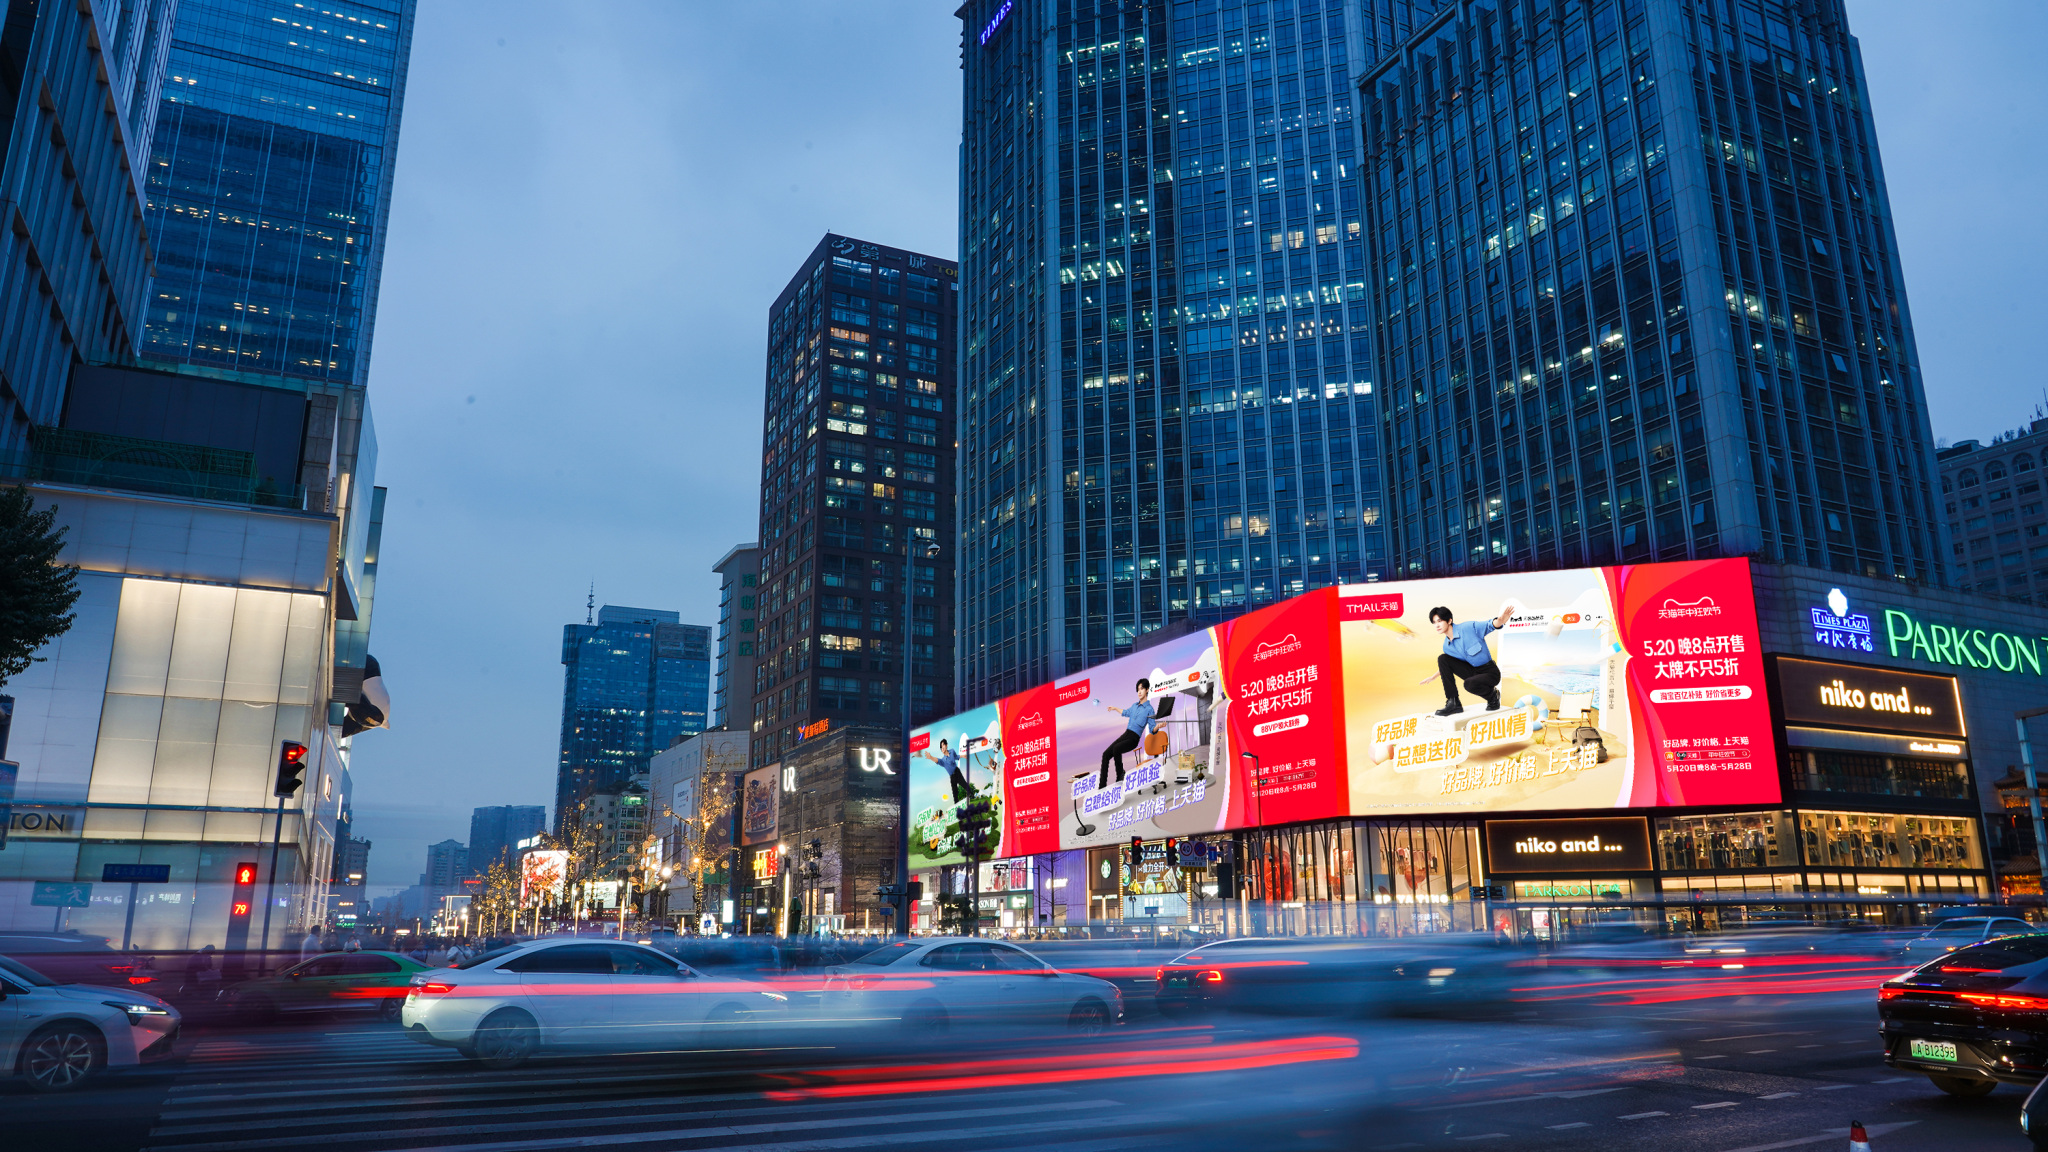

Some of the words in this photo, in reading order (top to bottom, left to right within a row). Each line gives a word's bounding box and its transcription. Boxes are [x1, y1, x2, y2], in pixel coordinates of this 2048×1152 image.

[980, 0, 1012, 46] TIMES
[860, 244, 927, 272] 第一城
[738, 573, 756, 656] 海悦酒店
[1658, 606, 1721, 619] 天猫年中狂欢节
[1815, 611, 1841, 626] TIMES
[1843, 617, 1868, 630] PLAZA
[1643, 639, 1675, 656] 5.20
[1678, 635, 1745, 655] 晚8点开售
[1885, 609, 2041, 676] PARKSON
[1241, 680, 1264, 698] 5.20
[1266, 665, 1318, 692] 晚8点开售
[1654, 658, 1739, 679] 大牌不只5折
[1247, 687, 1312, 717] 大牌不只5折
[1820, 680, 1865, 709] niko
[1870, 687, 1911, 714] and
[1375, 718, 1418, 743] 好品牌
[1470, 712, 1527, 745] 好心情
[859, 747, 897, 775] UR
[1396, 737, 1462, 767] 总想送你
[783, 766, 797, 792] UR
[1073, 774, 1097, 796] 好品牌
[1125, 762, 1161, 792] 好体验
[1084, 786, 1122, 813] 总想给你
[1515, 837, 1557, 853] niko
[1561, 836, 1600, 852] and
[1524, 884, 1592, 897] PARKSON
[234, 904, 247, 915] 79
